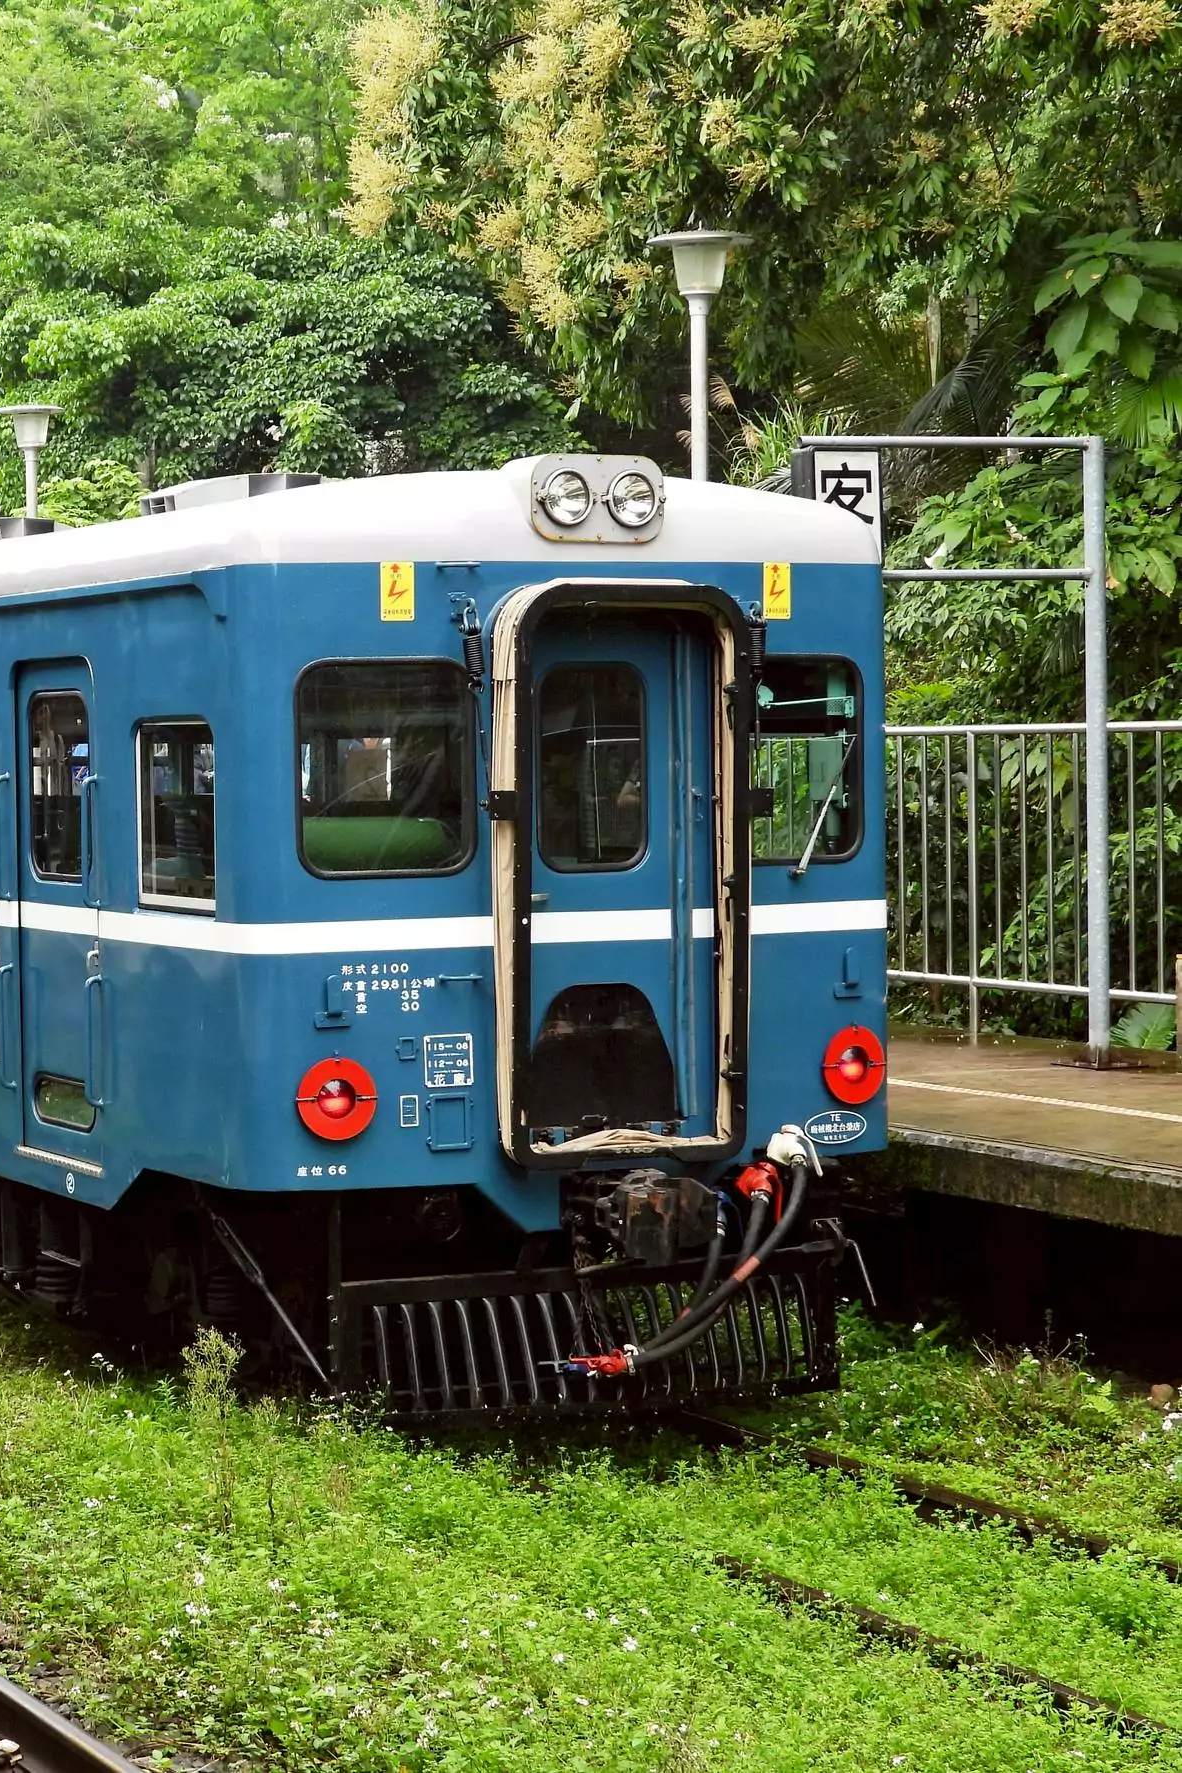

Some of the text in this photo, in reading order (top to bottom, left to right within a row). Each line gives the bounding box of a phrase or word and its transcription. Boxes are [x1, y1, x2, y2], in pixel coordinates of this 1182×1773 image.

[821, 462, 874, 525] 安
[371, 963, 409, 974] 2100
[401, 990, 419, 1000] 35
[401, 1001, 419, 1011] 30
[830, 1114, 841, 1122] TE
[297, 1164, 347, 1177] 座位 66
